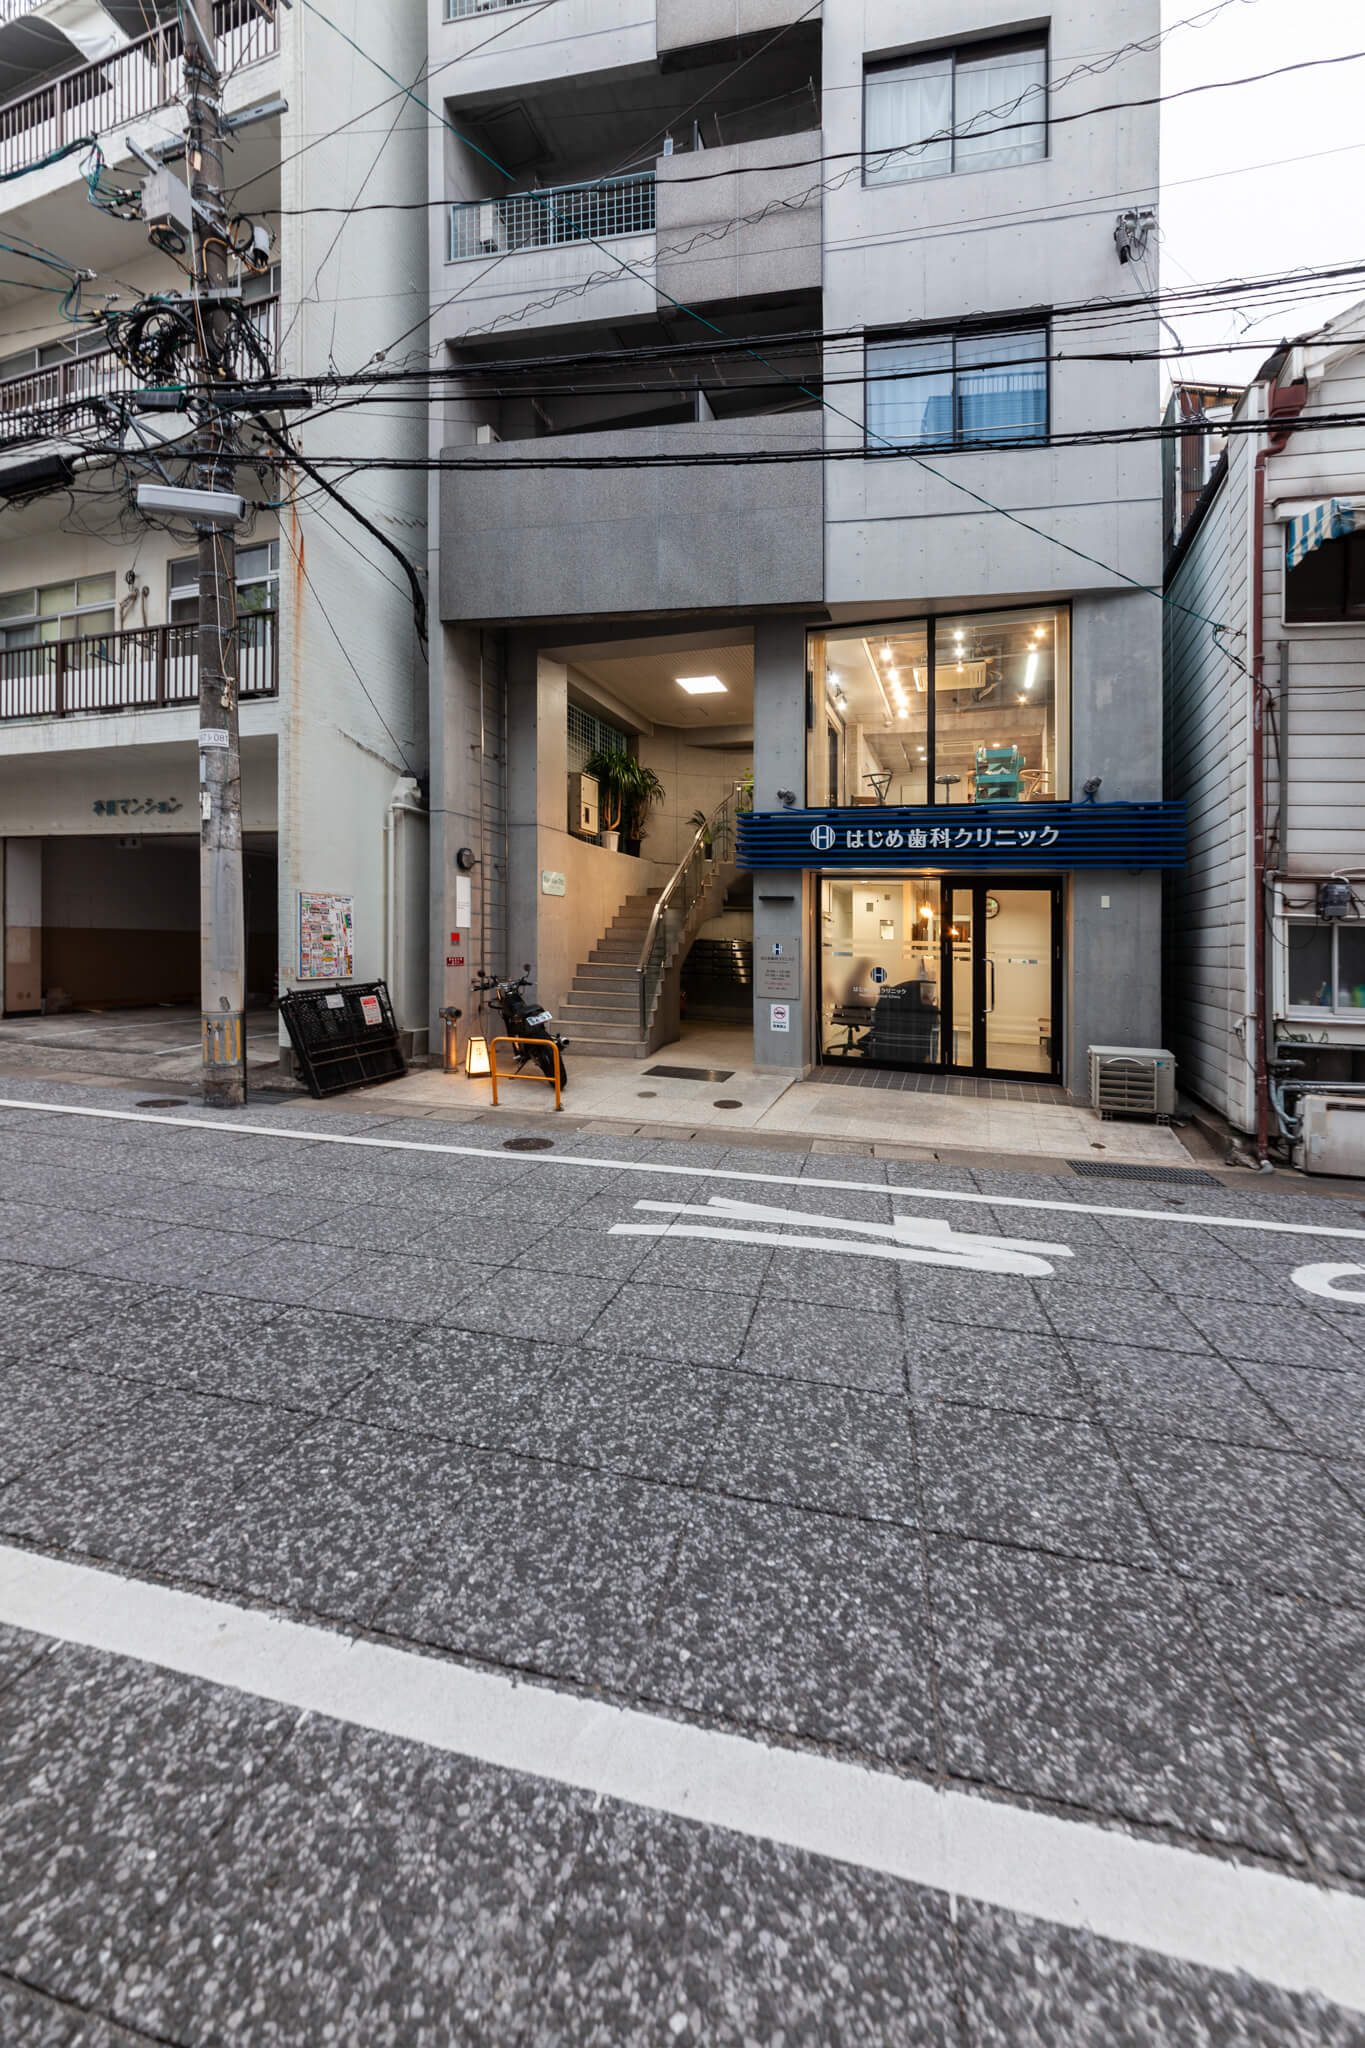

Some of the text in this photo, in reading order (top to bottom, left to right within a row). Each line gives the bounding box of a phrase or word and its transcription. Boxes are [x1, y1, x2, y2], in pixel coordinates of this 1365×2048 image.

[846, 825, 1060, 849] はじめ歯科クリニック
